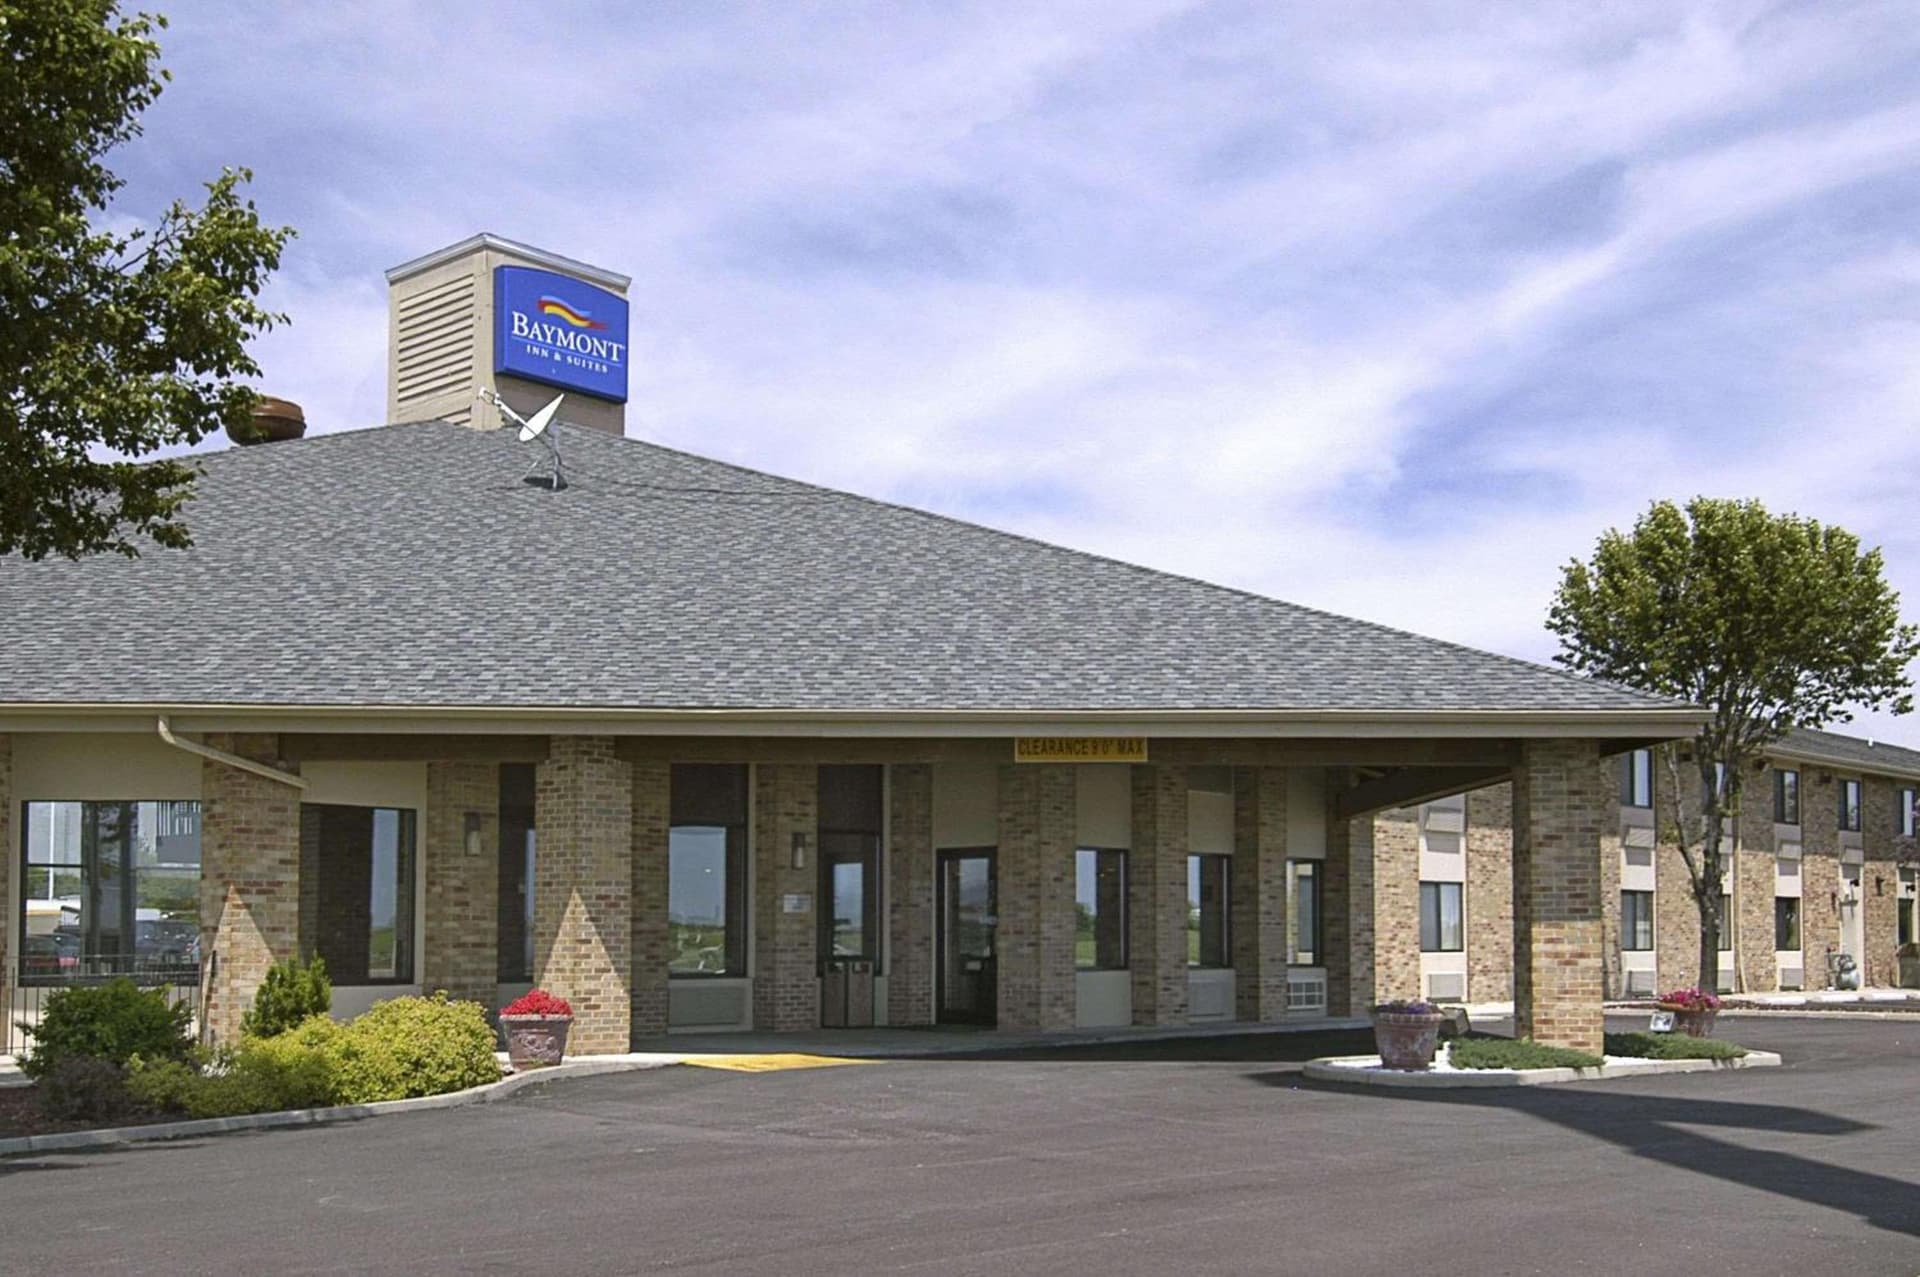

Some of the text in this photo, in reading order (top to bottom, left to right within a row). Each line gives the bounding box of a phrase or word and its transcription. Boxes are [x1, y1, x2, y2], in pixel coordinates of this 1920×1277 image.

[512, 311, 626, 362] BAYMONT
[526, 344, 608, 373] INN & SUITES
[1018, 737, 1089, 755] CLEARANCE
[1117, 737, 1145, 755] MAX
